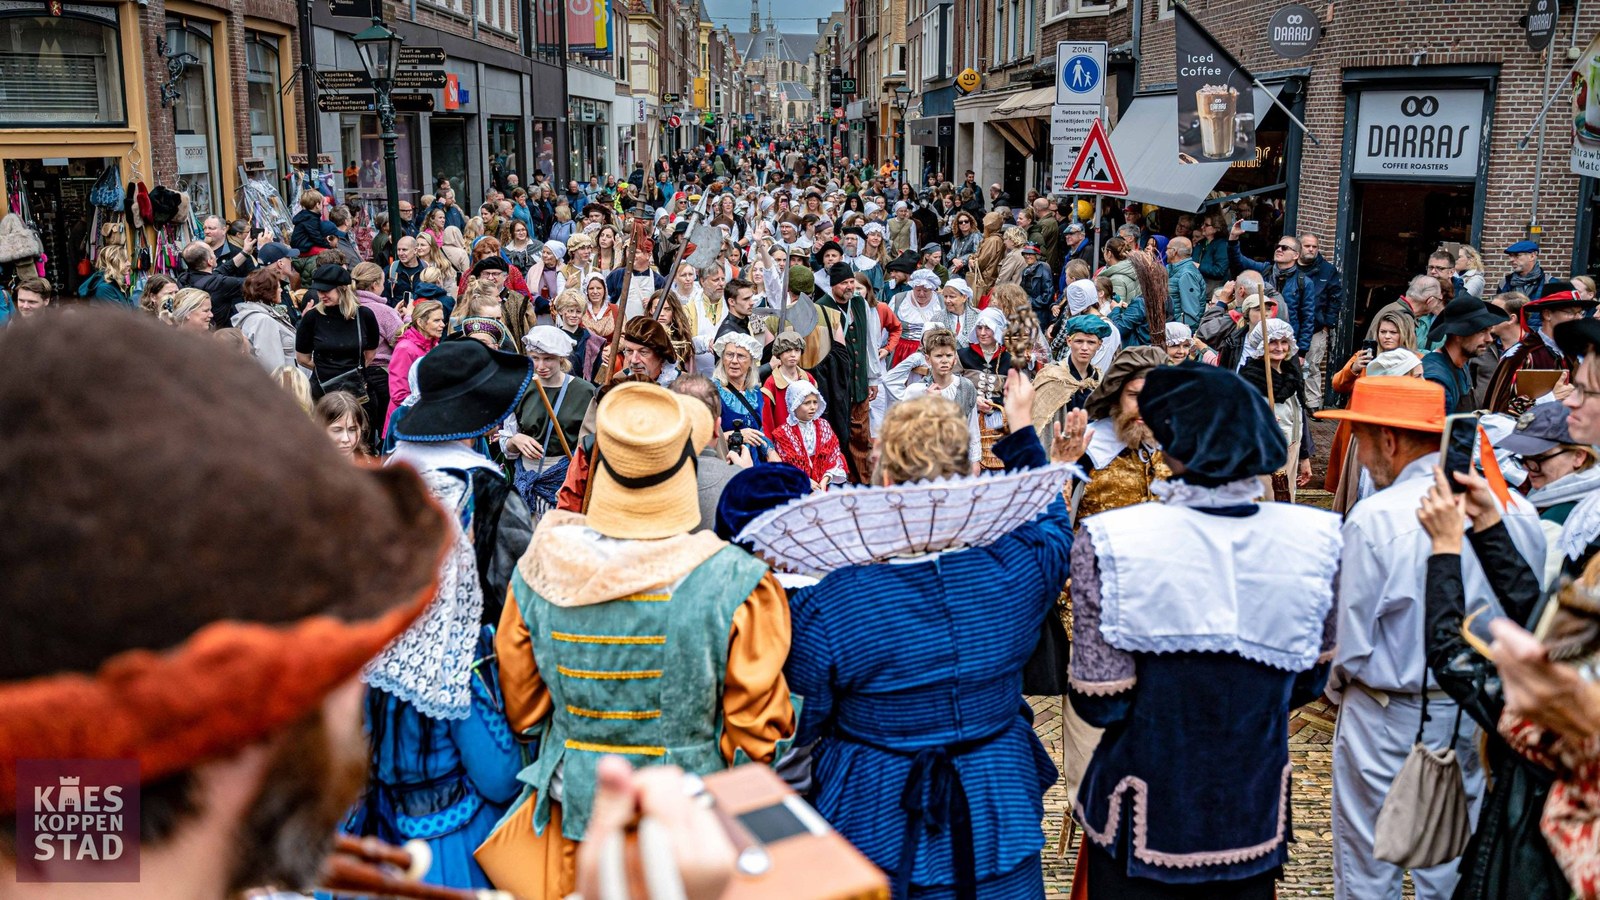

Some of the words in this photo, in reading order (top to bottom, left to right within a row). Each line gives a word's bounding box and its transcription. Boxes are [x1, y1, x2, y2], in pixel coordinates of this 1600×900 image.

[1528, 12, 1554, 32] DARRAS
[1273, 26, 1315, 41] DARRAS
[1187, 53, 1214, 63] Iced
[1181, 66, 1221, 77] Coffee
[1367, 125, 1470, 159] DARRAS
